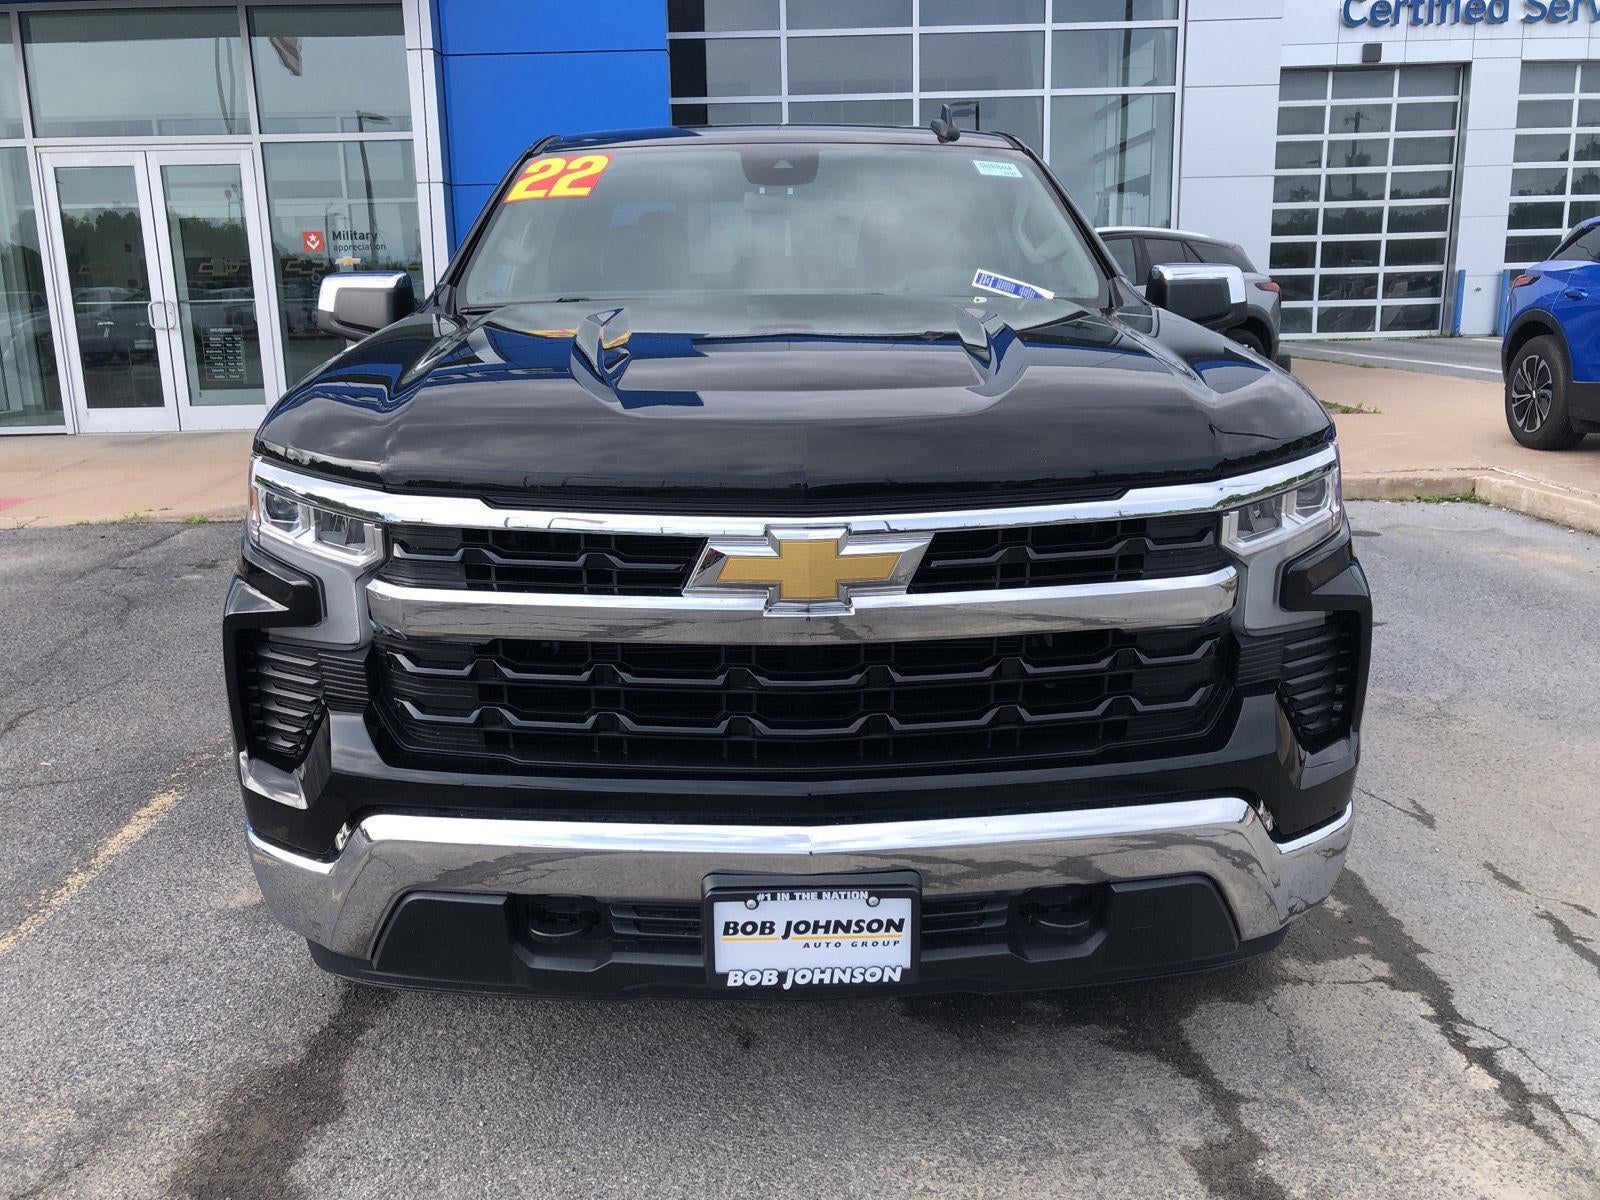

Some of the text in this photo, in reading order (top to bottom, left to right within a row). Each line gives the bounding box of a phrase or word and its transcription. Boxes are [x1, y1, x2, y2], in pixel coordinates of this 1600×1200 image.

[505, 155, 609, 200] 22
[332, 230, 378, 241] Military
[333, 242, 386, 252] appreciation
[757, 891, 869, 902] #1 IN THE NATION
[722, 918, 906, 940] BOB JOHNSON
[802, 940, 900, 949] AUTO GROUP
[727, 966, 902, 990] BOB JOHNSON
